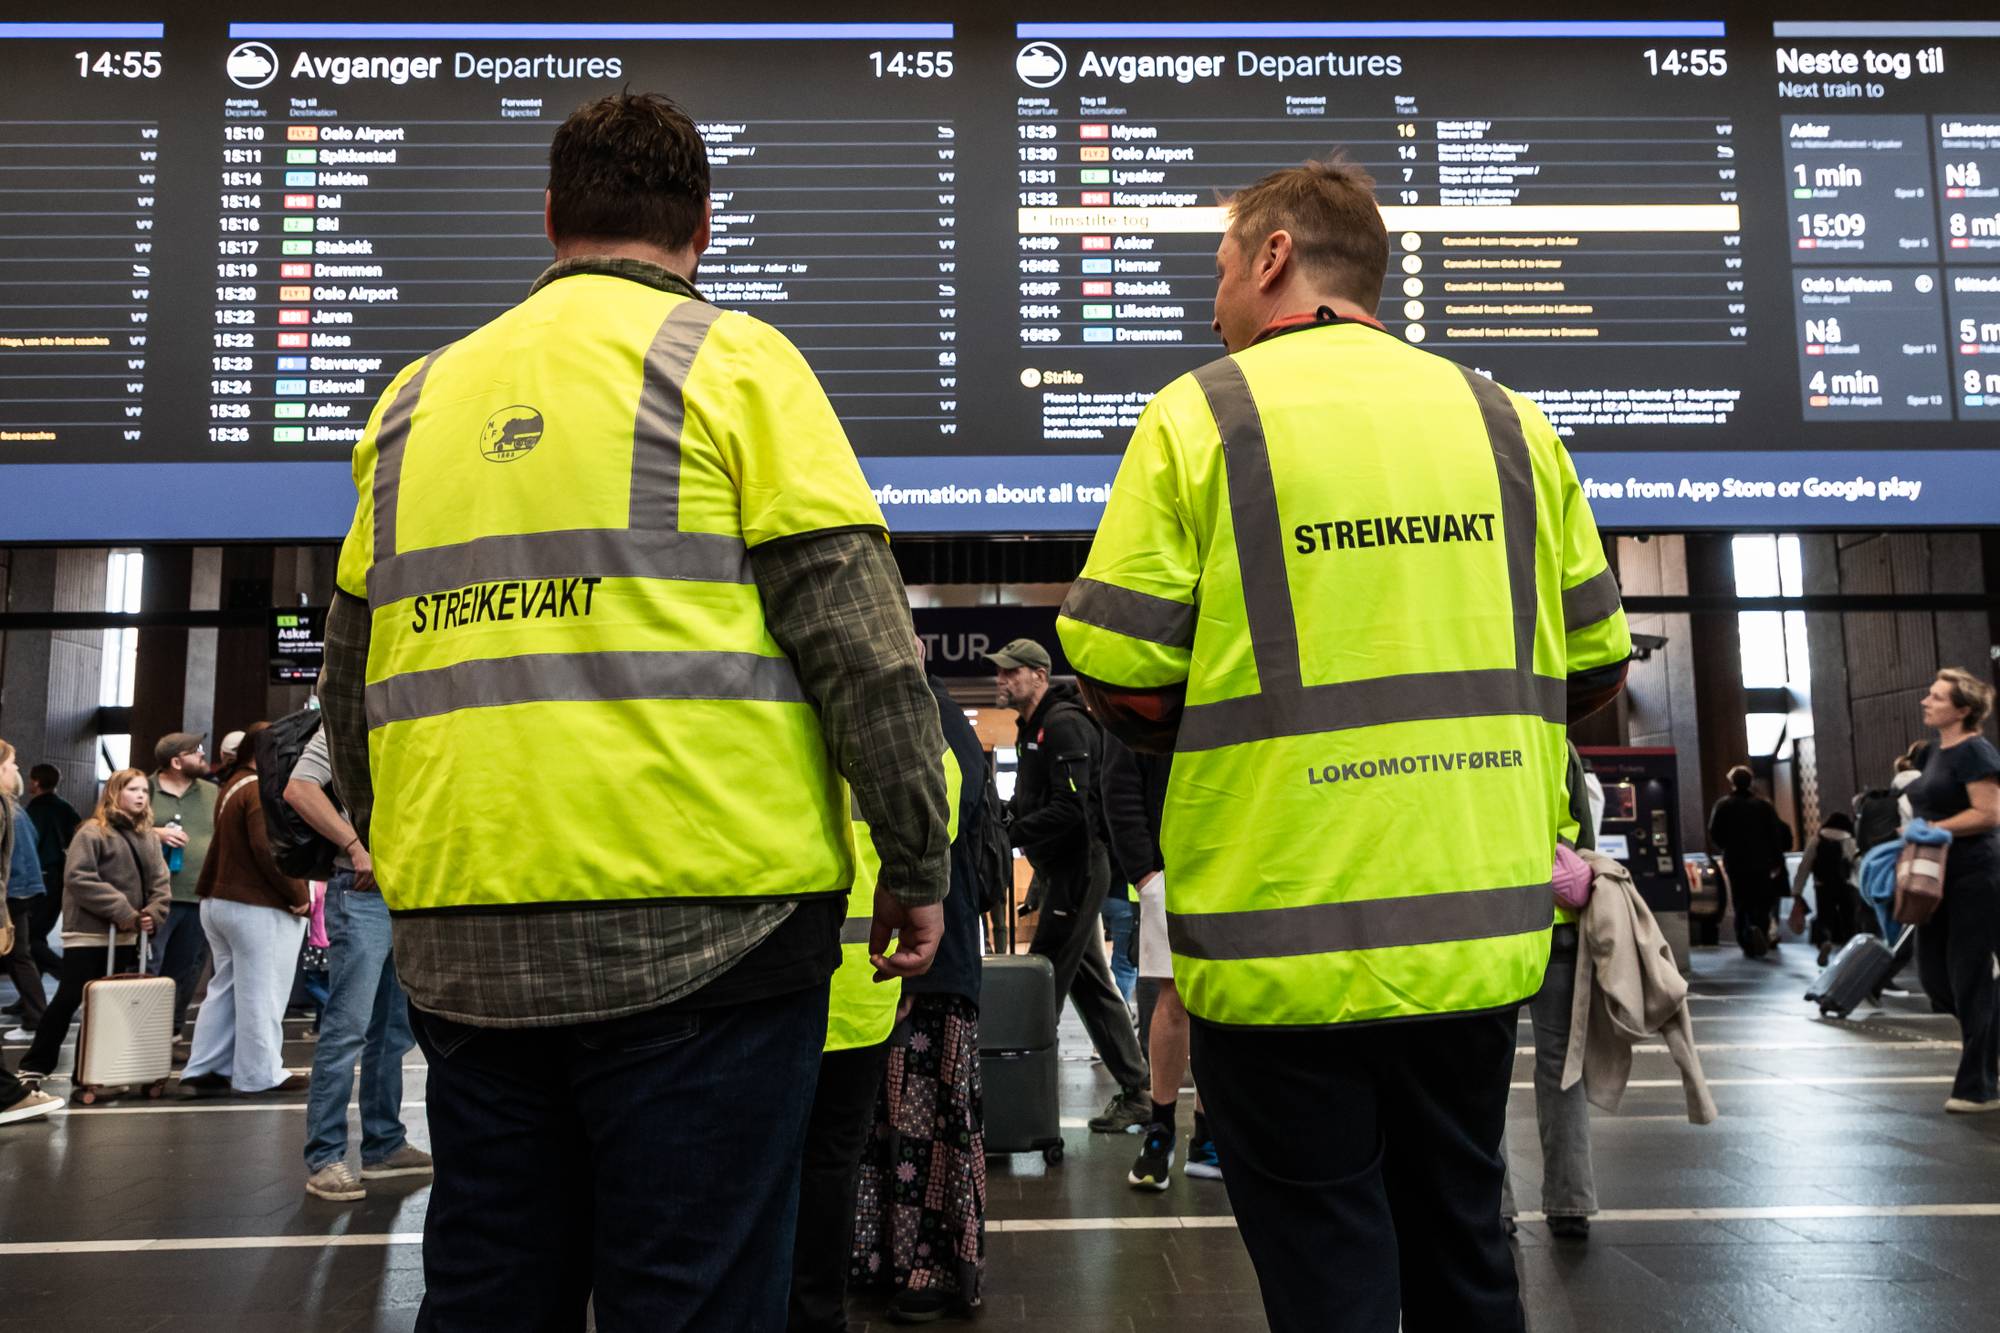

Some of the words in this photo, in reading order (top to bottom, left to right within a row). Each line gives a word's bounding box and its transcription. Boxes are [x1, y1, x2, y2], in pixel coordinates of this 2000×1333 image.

[76, 52, 161, 78] 14:55
[291, 52, 442, 84] Avganger
[455, 53, 621, 83] Departures
[870, 52, 953, 77] 14:55
[1079, 51, 1225, 83] Avganger
[1238, 51, 1401, 82] Departures
[1644, 49, 1727, 76] 14:55
[1777, 48, 1858, 73] Neste
[1863, 50, 1911, 79] tog
[1916, 47, 1943, 73] til
[1779, 82, 1819, 97] Next
[1823, 82, 1862, 97] train
[1866, 83, 1884, 97] to
[225, 98, 259, 108] Avgang
[290, 98, 306, 108] Tog
[308, 98, 317, 107] til
[501, 98, 543, 107] Forventet
[1018, 97, 1050, 106] Avgang
[1080, 97, 1096, 106] Tog
[1097, 97, 1107, 105] til
[290, 108, 337, 116] Destination
[1080, 107, 1127, 115] Destination
[225, 127, 264, 140] 15:10
[321, 126, 353, 140] Oslo
[355, 127, 404, 143] Airport
[1018, 125, 1056, 138] 15:29
[1398, 124, 1415, 137] 16
[1790, 123, 1830, 137] Asker
[1941, 122, 2000, 138] Lillestrø
[223, 149, 261, 163] 15:11
[1112, 146, 1144, 160] Oslo
[1146, 147, 1193, 163] Airport
[1398, 146, 1416, 159] 14
[222, 172, 262, 185] 15:14
[319, 172, 368, 185] Halden
[1113, 169, 1165, 185] Lysaker
[1403, 168, 1413, 182] 7
[1794, 164, 1806, 186] 1
[1816, 164, 1861, 186] min
[1946, 162, 1980, 186] Nå
[221, 195, 261, 208] 15:14
[318, 194, 341, 208] Dal
[1113, 192, 1198, 206] Kongsvinger
[1894, 188, 1916, 199] Spor
[220, 218, 259, 231] 15:16
[316, 217, 339, 231] Ski
[1050, 214, 1117, 226] Innstilte
[1123, 215, 1149, 228] tog
[1798, 214, 1865, 237] 15:09
[1950, 214, 1966, 236] 8
[1972, 213, 2000, 236] mi
[219, 241, 258, 254] 15:17
[315, 240, 372, 254] Stabekk
[1114, 236, 1154, 249] Asker
[1899, 238, 1920, 249] Spor
[217, 264, 257, 277] 15:19
[315, 264, 382, 277] Drammen
[1115, 259, 1161, 272] Hamar
[1115, 281, 1170, 295] Stabekk
[1802, 277, 1834, 292] Oslo
[1835, 277, 1892, 292] lufthavn
[216, 287, 256, 300] 15:20
[313, 286, 346, 300] Oslo
[348, 287, 398, 303] Airport
[215, 310, 255, 324] 15:22
[312, 310, 352, 323] Jaren
[1116, 328, 1182, 341] Drammen
[1806, 318, 1841, 342] Nå
[1961, 319, 1976, 342] 5
[214, 334, 254, 347] 15:22
[312, 333, 351, 347] Moss
[1902, 344, 1924, 354] Spor
[310, 357, 382, 373] Stavanger
[1043, 370, 1083, 384] Strike
[1809, 371, 1826, 393] 4
[1832, 370, 1878, 393] min
[1964, 370, 1981, 393] 8
[212, 380, 251, 394] 15:24
[309, 379, 364, 393] Eidsvoll
[1907, 395, 1929, 406] Spor
[308, 403, 350, 417] Asker
[872, 484, 982, 504] nformation
[985, 484, 1046, 503] about
[1049, 483, 1072, 503] all
[1076, 484, 1112, 503] trai
[1583, 478, 1622, 498] free
[1626, 478, 1674, 498] from
[1678, 478, 1720, 501] App
[1722, 478, 1776, 498] Store
[1778, 480, 1801, 498] or
[1803, 476, 1876, 502] Google
[1879, 476, 1922, 502] play
[1294, 514, 1495, 554] STREIKEVAKT
[412, 577, 601, 634] STREIKEVAKT
[278, 628, 310, 640] Asker
[1308, 750, 1523, 785] LOKOMOTIVFØRER
